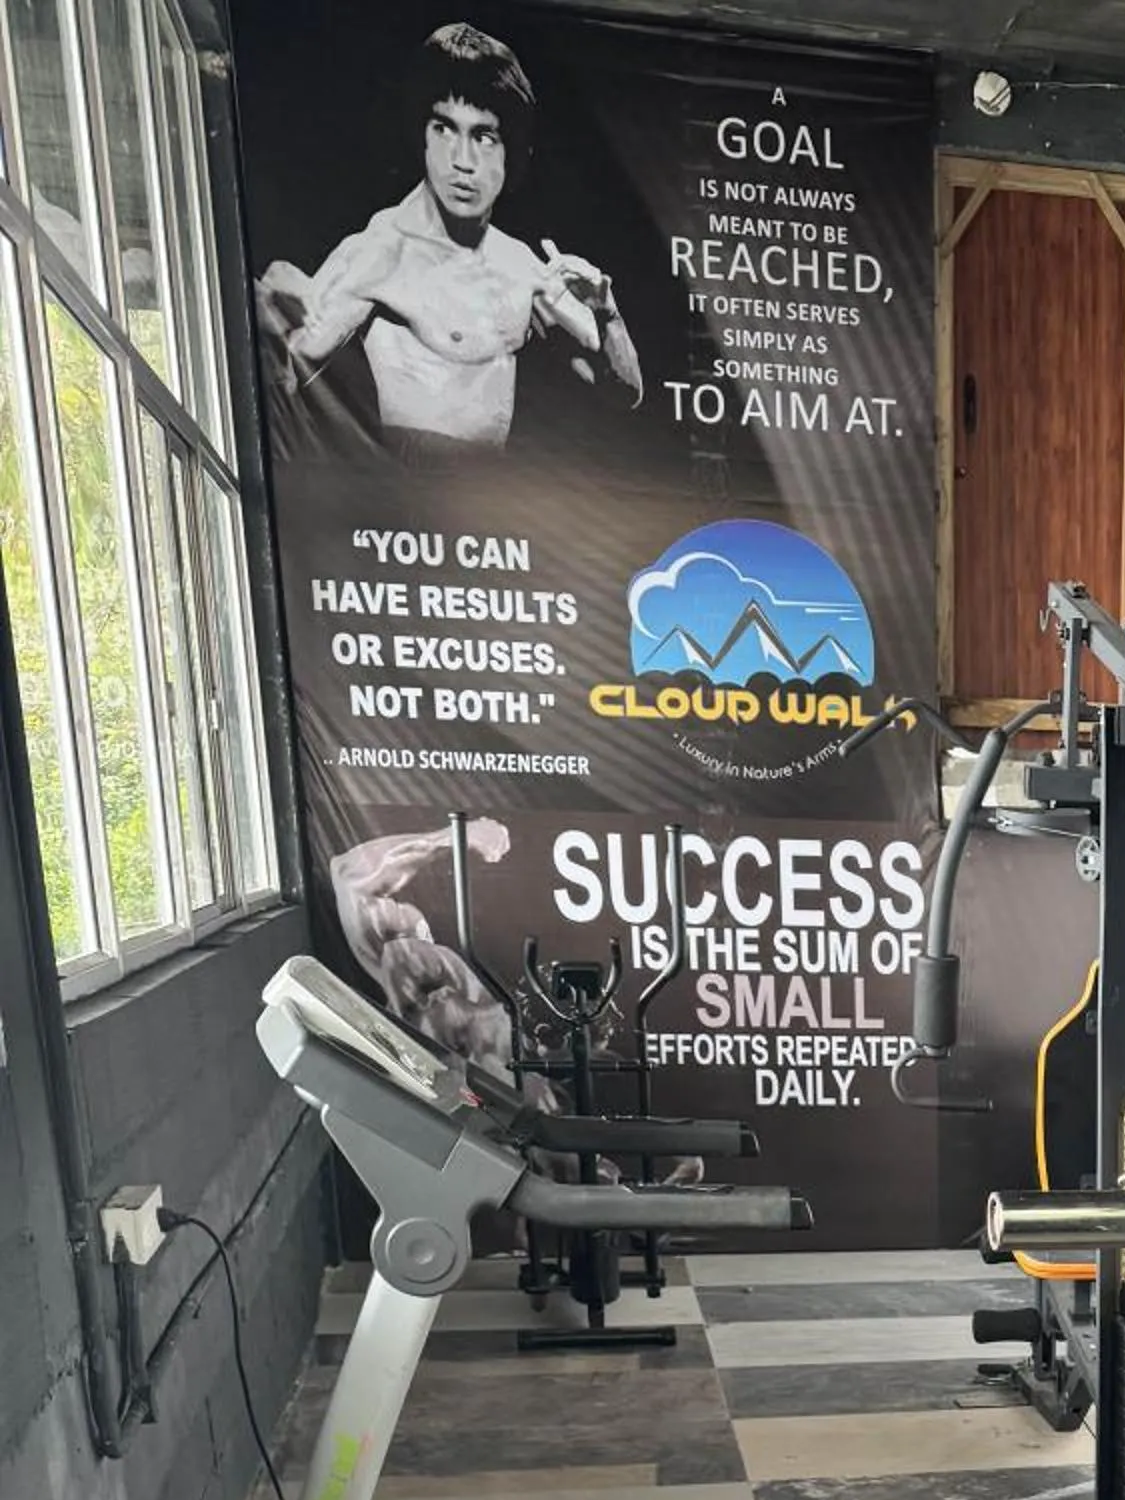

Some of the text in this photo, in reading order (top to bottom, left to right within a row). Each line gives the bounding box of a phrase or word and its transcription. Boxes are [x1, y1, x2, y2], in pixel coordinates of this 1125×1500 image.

[772, 87, 787, 106] A
[717, 117, 844, 170] GOAL
[700, 179, 856, 212] IS NOT ALWAYS
[709, 214, 849, 245] MEANT TO BE
[670, 236, 894, 303] REACHED,
[689, 293, 860, 325] IT OFTEN SERVES
[723, 328, 828, 354] SIMPLY AS
[713, 359, 839, 386] SOMETHING
[663, 381, 903, 437] TO AIM AT.
[455, 535, 530, 571] CAN
[311, 579, 578, 625] HAVE RESULTS
[331, 633, 566, 675] OR EXCUSES.
[349, 685, 422, 719] NOT
[589, 684, 760, 726] CLOUD
[337, 747, 414, 769] ARNOLD
[419, 750, 590, 776] SCHWARZENEGGER
[679, 736, 724, 772] Luxury
[743, 761, 804, 779] Nature's
[805, 742, 837, 769] Arms
[553, 829, 924, 930] SUCCESS
[631, 925, 923, 975] IS THE SUM OF
[695, 973, 884, 1029] SMALL
[645, 1033, 769, 1066] EFFORTS
[755, 1069, 860, 1106] DAILY.
